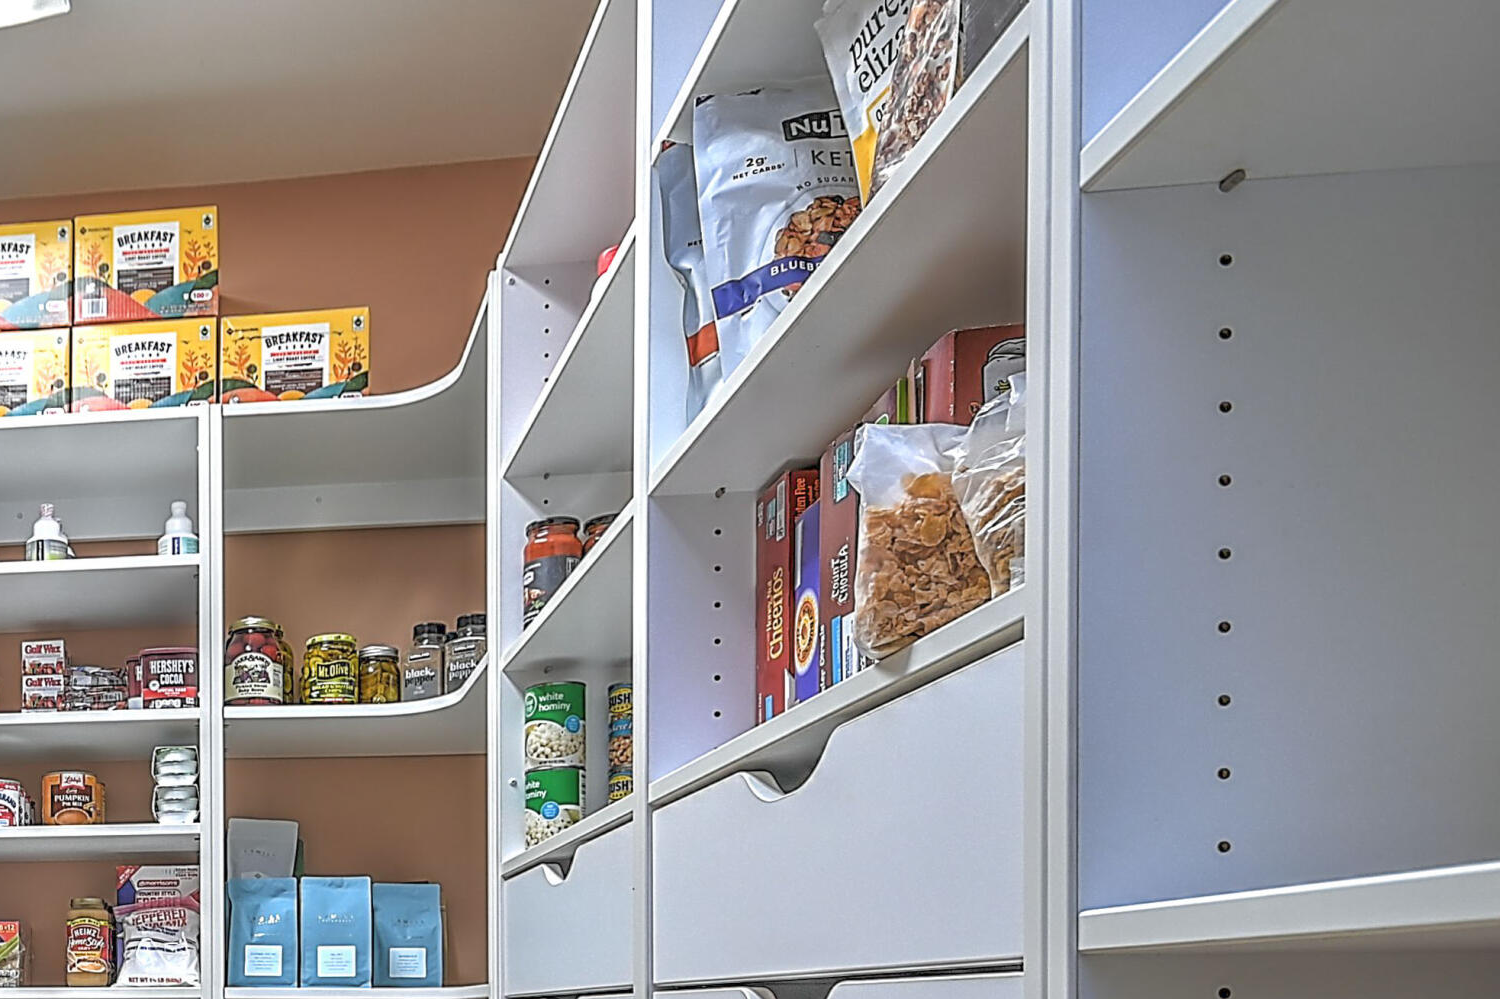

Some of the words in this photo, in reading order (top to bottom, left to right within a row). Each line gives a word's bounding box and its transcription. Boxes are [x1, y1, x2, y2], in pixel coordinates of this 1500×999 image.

[849, 0, 909, 73] pure
[812, 150, 854, 167] KET
[733, 172, 749, 180] NET
[796, 181, 811, 191] NO
[117, 230, 175, 247] BREAKFAST
[771, 261, 820, 276] BLUEB
[265, 331, 324, 348] BREAKFAST
[114, 341, 173, 357] BREAKFAST
[768, 566, 784, 660] Cheerios
[43, 643, 62, 654] Wax
[149, 660, 194, 675] HERSHEY'S
[449, 659, 477, 672] black
[160, 673, 184, 685] COCOA
[405, 667, 435, 679] black
[449, 670, 472, 681] pepp
[43, 677, 62, 688] Wax
[405, 675, 436, 688] pepper
[538, 692, 564, 703] white
[538, 702, 571, 712] hominy
[54, 794, 90, 802] PUMPKIN
[74, 928, 98, 937] HEINZ
